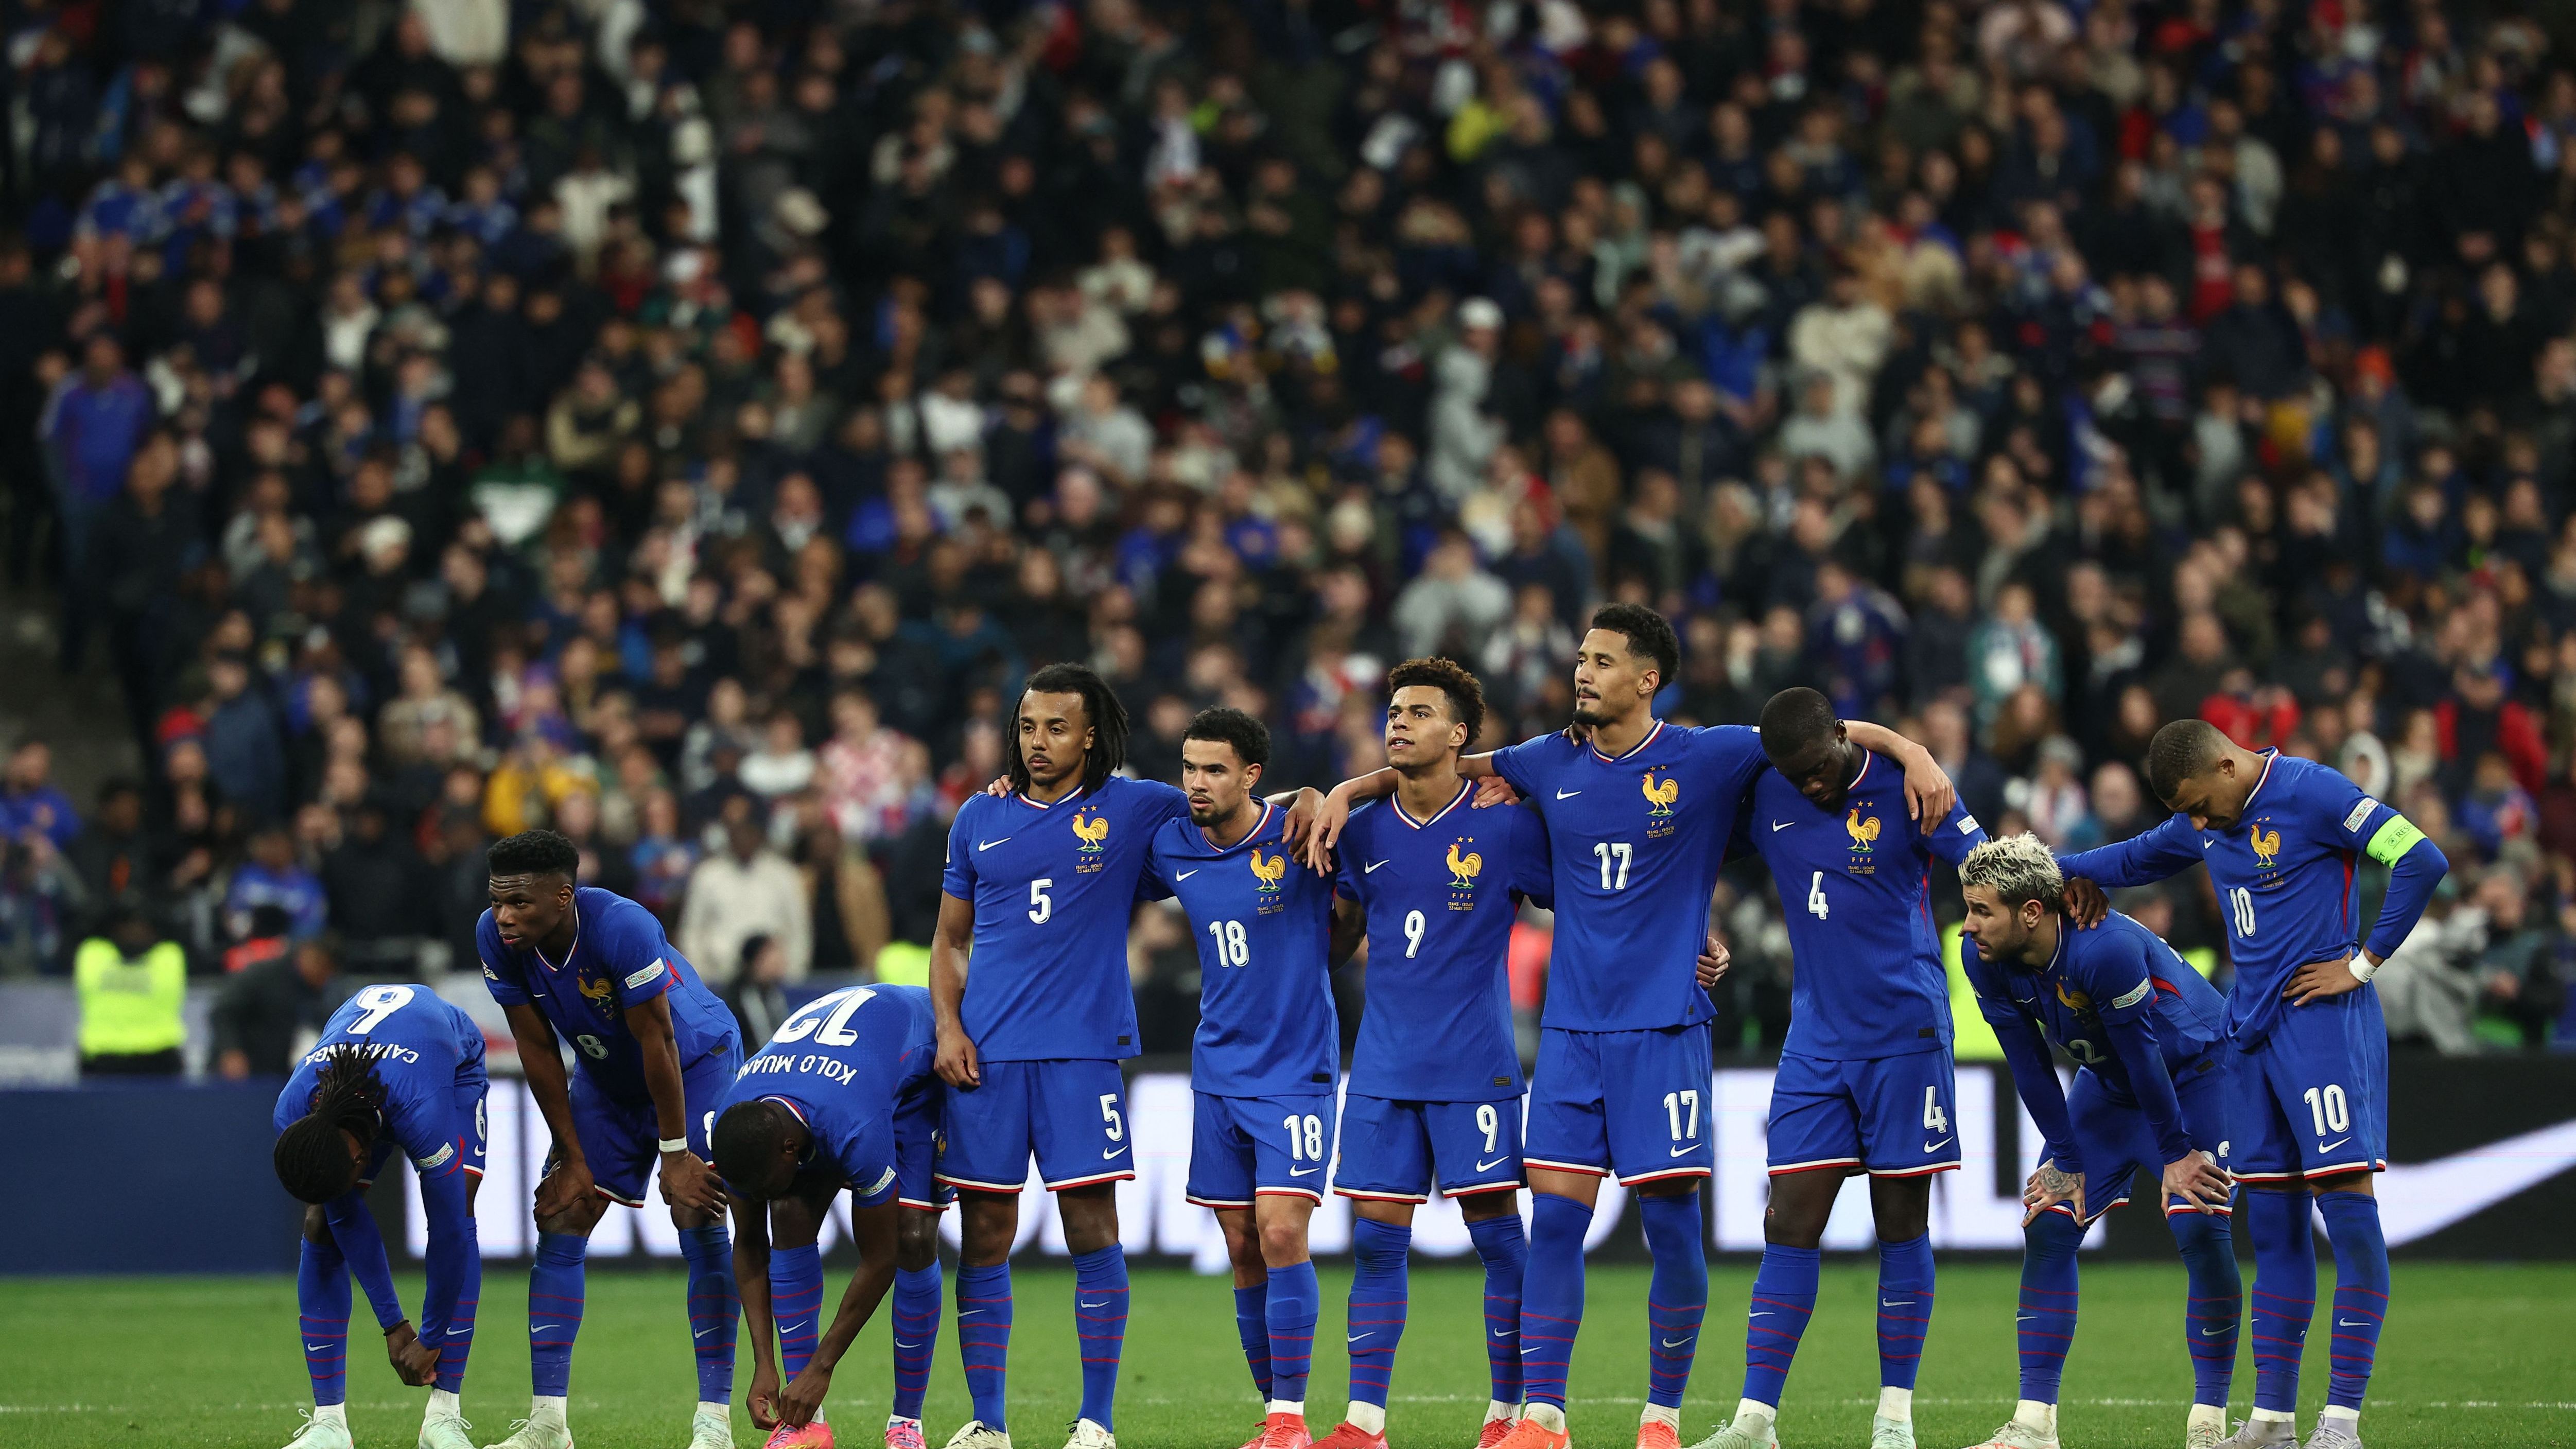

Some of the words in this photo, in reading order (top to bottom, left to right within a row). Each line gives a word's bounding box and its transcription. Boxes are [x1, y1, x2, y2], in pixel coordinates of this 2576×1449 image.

[1594, 842, 1632, 889] 17
[1029, 878, 1052, 924] 5
[1808, 871, 1829, 920] 4
[2230, 886, 2256, 938] 10
[1209, 920, 1249, 967] 18
[1404, 910, 1425, 958] 9
[346, 986, 415, 1035] 6
[772, 988, 877, 1047] 12
[577, 1035, 608, 1060] 8
[799, 1054, 858, 1086] KOLO
[475, 1098, 486, 1144] 6
[1099, 1093, 1123, 1142] 5
[1476, 1104, 1498, 1153] 9
[1663, 1089, 1698, 1141] 17
[1923, 1086, 1947, 1133] 4
[2304, 1084, 2349, 1137] 10
[1283, 1114, 1322, 1162] 18
